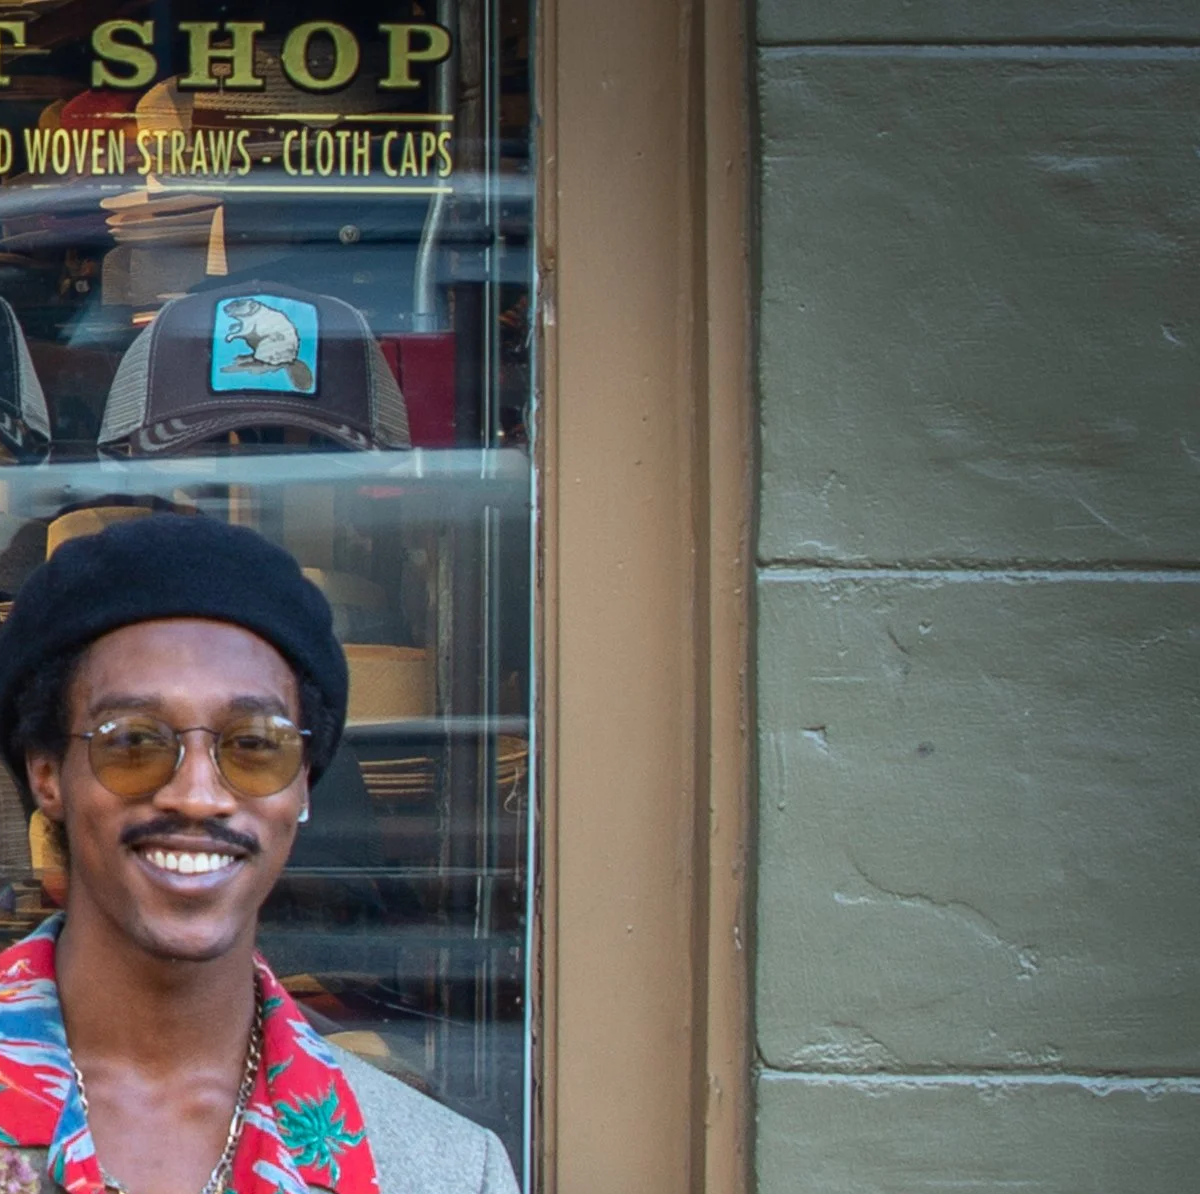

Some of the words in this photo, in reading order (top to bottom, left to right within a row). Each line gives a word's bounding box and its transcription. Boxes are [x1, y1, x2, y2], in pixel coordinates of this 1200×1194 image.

[91, 20, 452, 89] SHOP
[24, 128, 125, 174] WOVEN
[137, 130, 250, 174] STRAWS
[283, 131, 370, 176] CLOTH
[382, 131, 452, 177] CAPS
